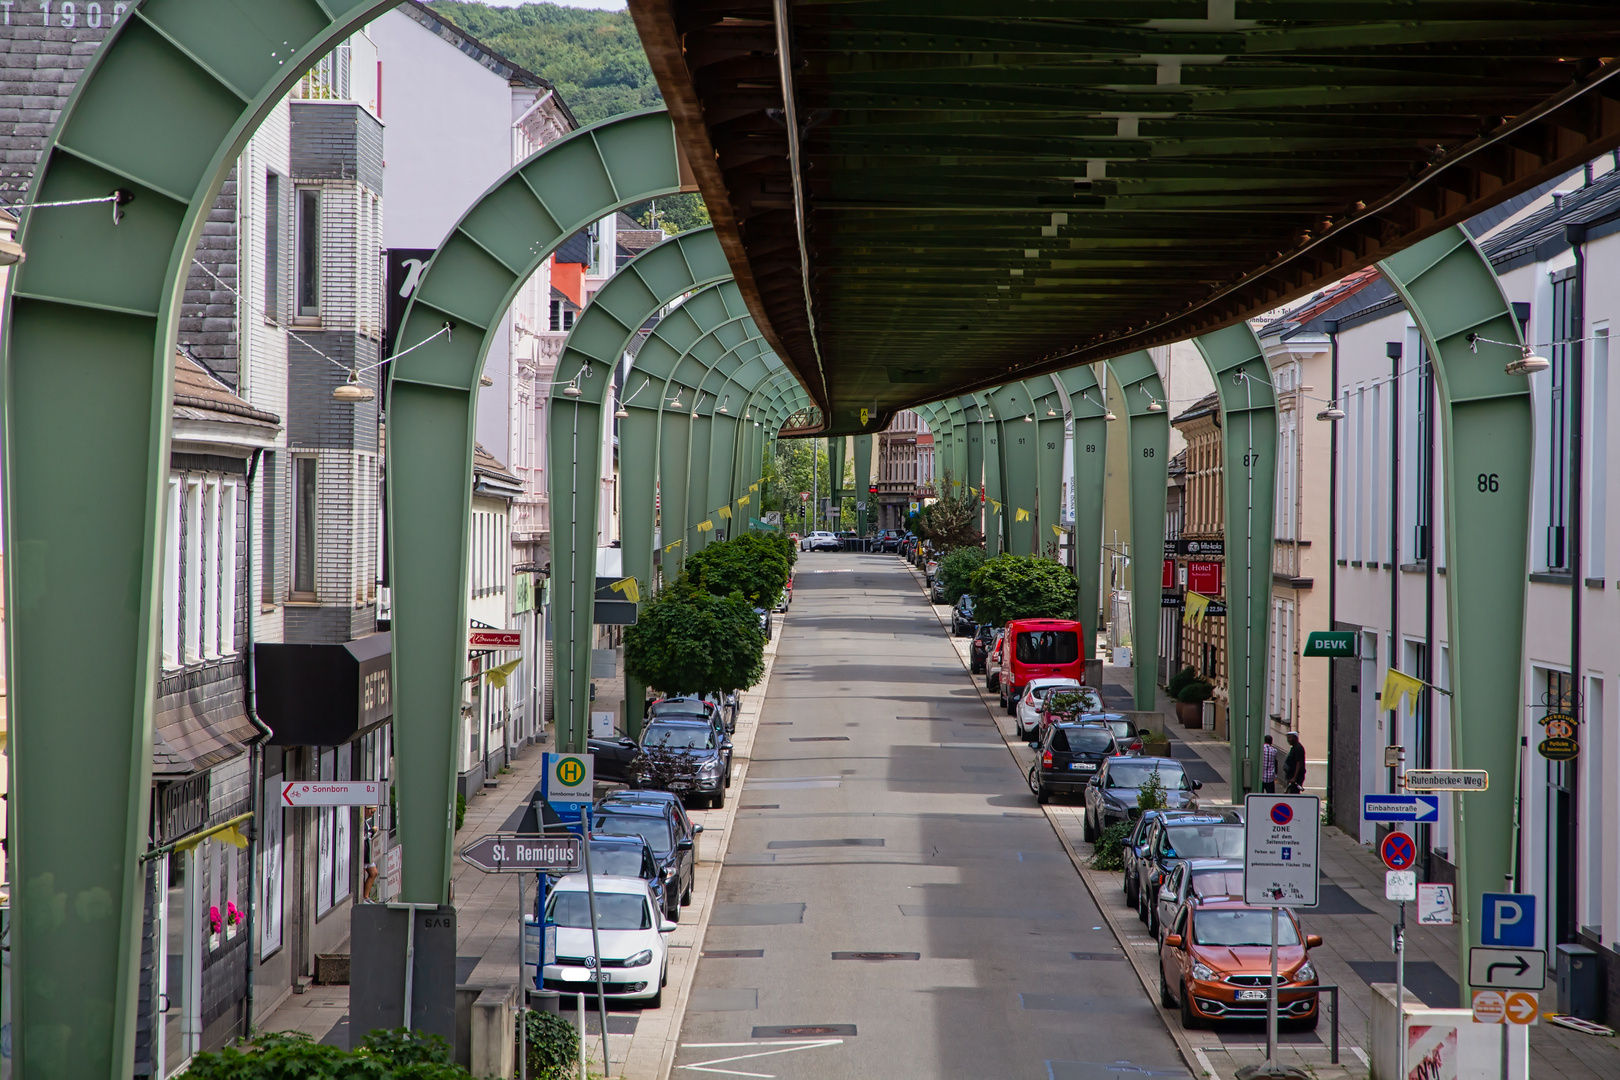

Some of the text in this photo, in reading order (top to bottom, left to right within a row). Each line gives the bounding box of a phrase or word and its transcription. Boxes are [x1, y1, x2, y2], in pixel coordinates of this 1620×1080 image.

[1018, 437, 1026, 445] 91
[1046, 442, 1056, 450] 90
[1085, 444, 1096, 453] 89
[1143, 447, 1155, 458] 88
[1243, 454, 1260, 467] 87
[1477, 472, 1499, 493] 86
[1315, 640, 1348, 649] DEVK
[1464, 776, 1483, 787] Weg
[312, 785, 349, 793] Sonnborn
[1367, 804, 1418, 812] Einbahnstraße
[493, 844, 574, 863] St. Remigius
[425, 918, 450, 928] BVS
[1493, 900, 1523, 940] P
